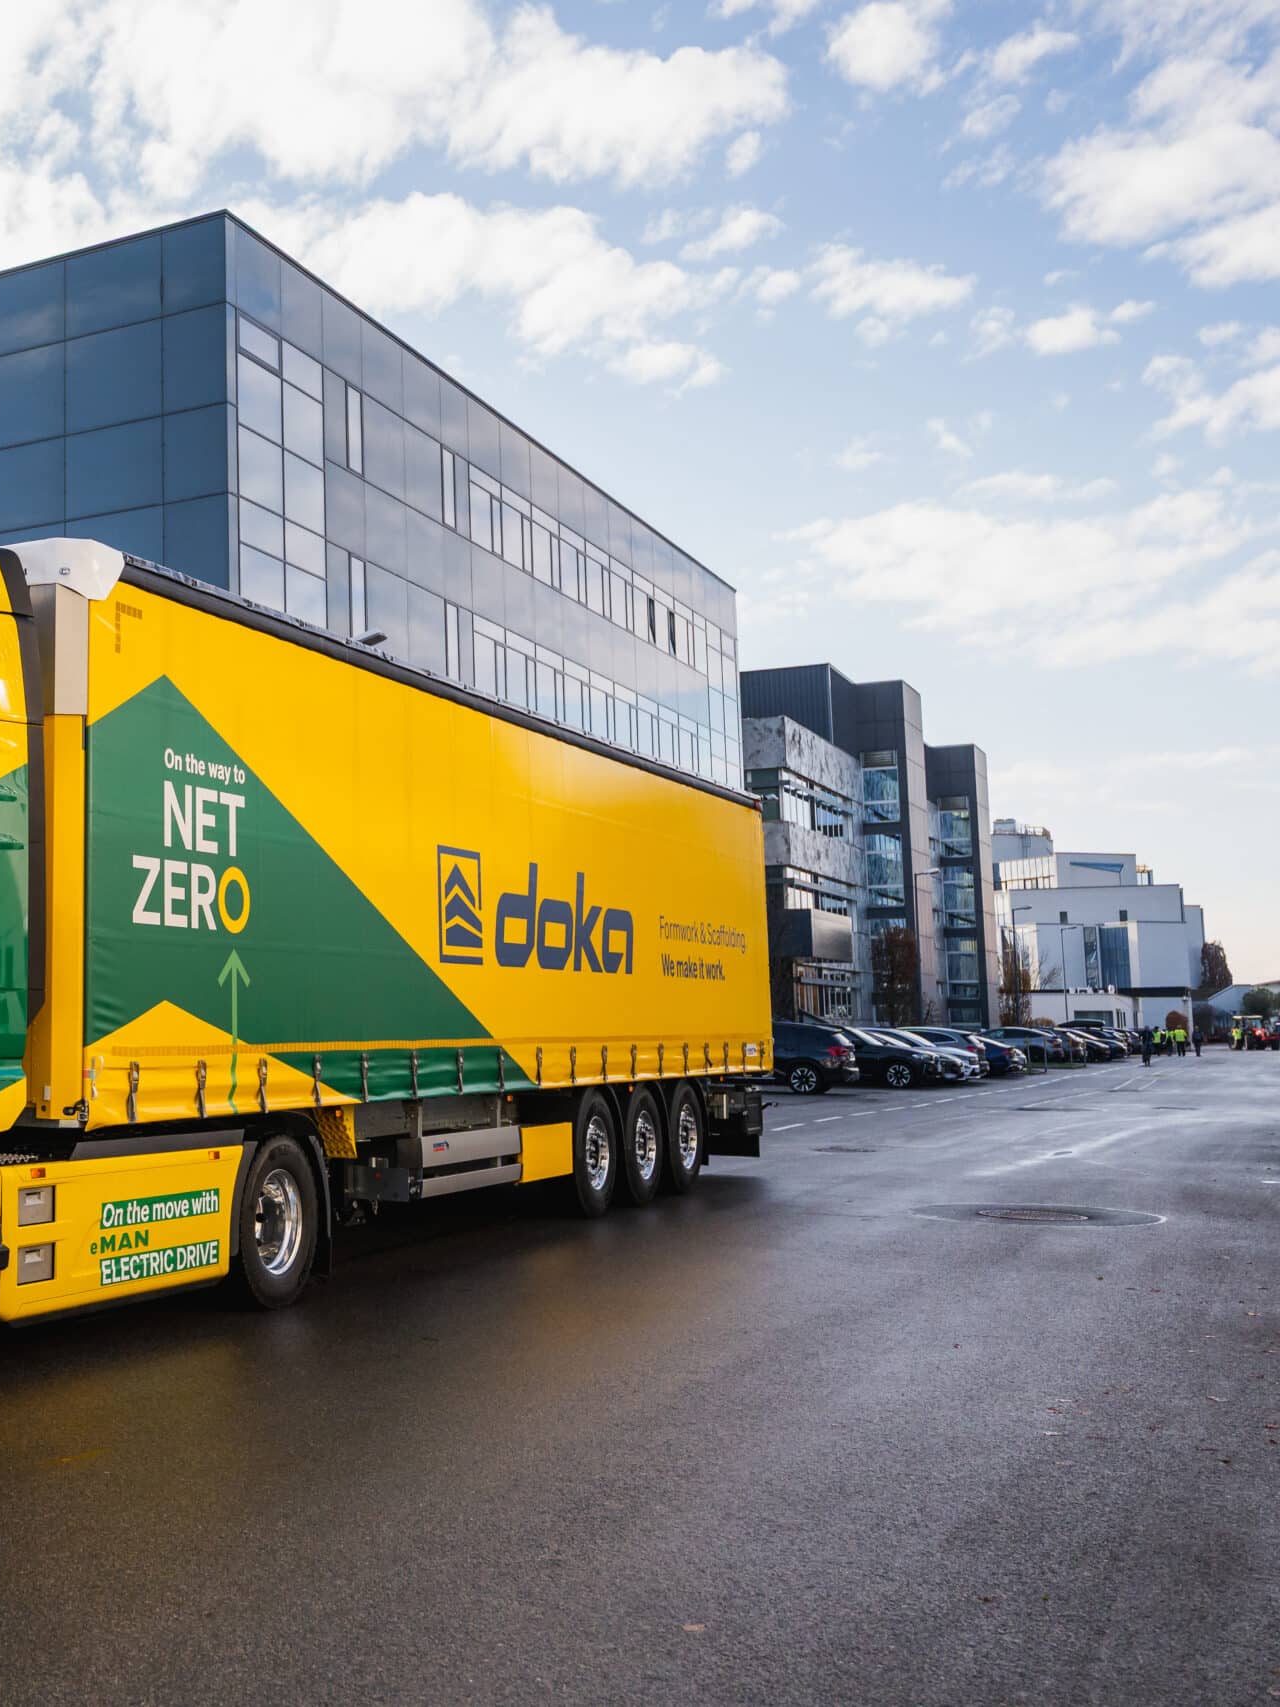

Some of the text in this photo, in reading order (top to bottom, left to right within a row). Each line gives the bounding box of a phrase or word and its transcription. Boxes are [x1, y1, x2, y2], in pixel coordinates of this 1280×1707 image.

[164, 748, 246, 786] On the way to
[163, 780, 246, 857] NET
[132, 854, 251, 934] ZERO
[495, 862, 634, 975] doka
[659, 915, 746, 954] Formwork & Scaffolding
[661, 953, 725, 981] We make it work.
[102, 1190, 219, 1228] On the move with
[101, 1240, 218, 1285] ELECTRIC DRIVE
